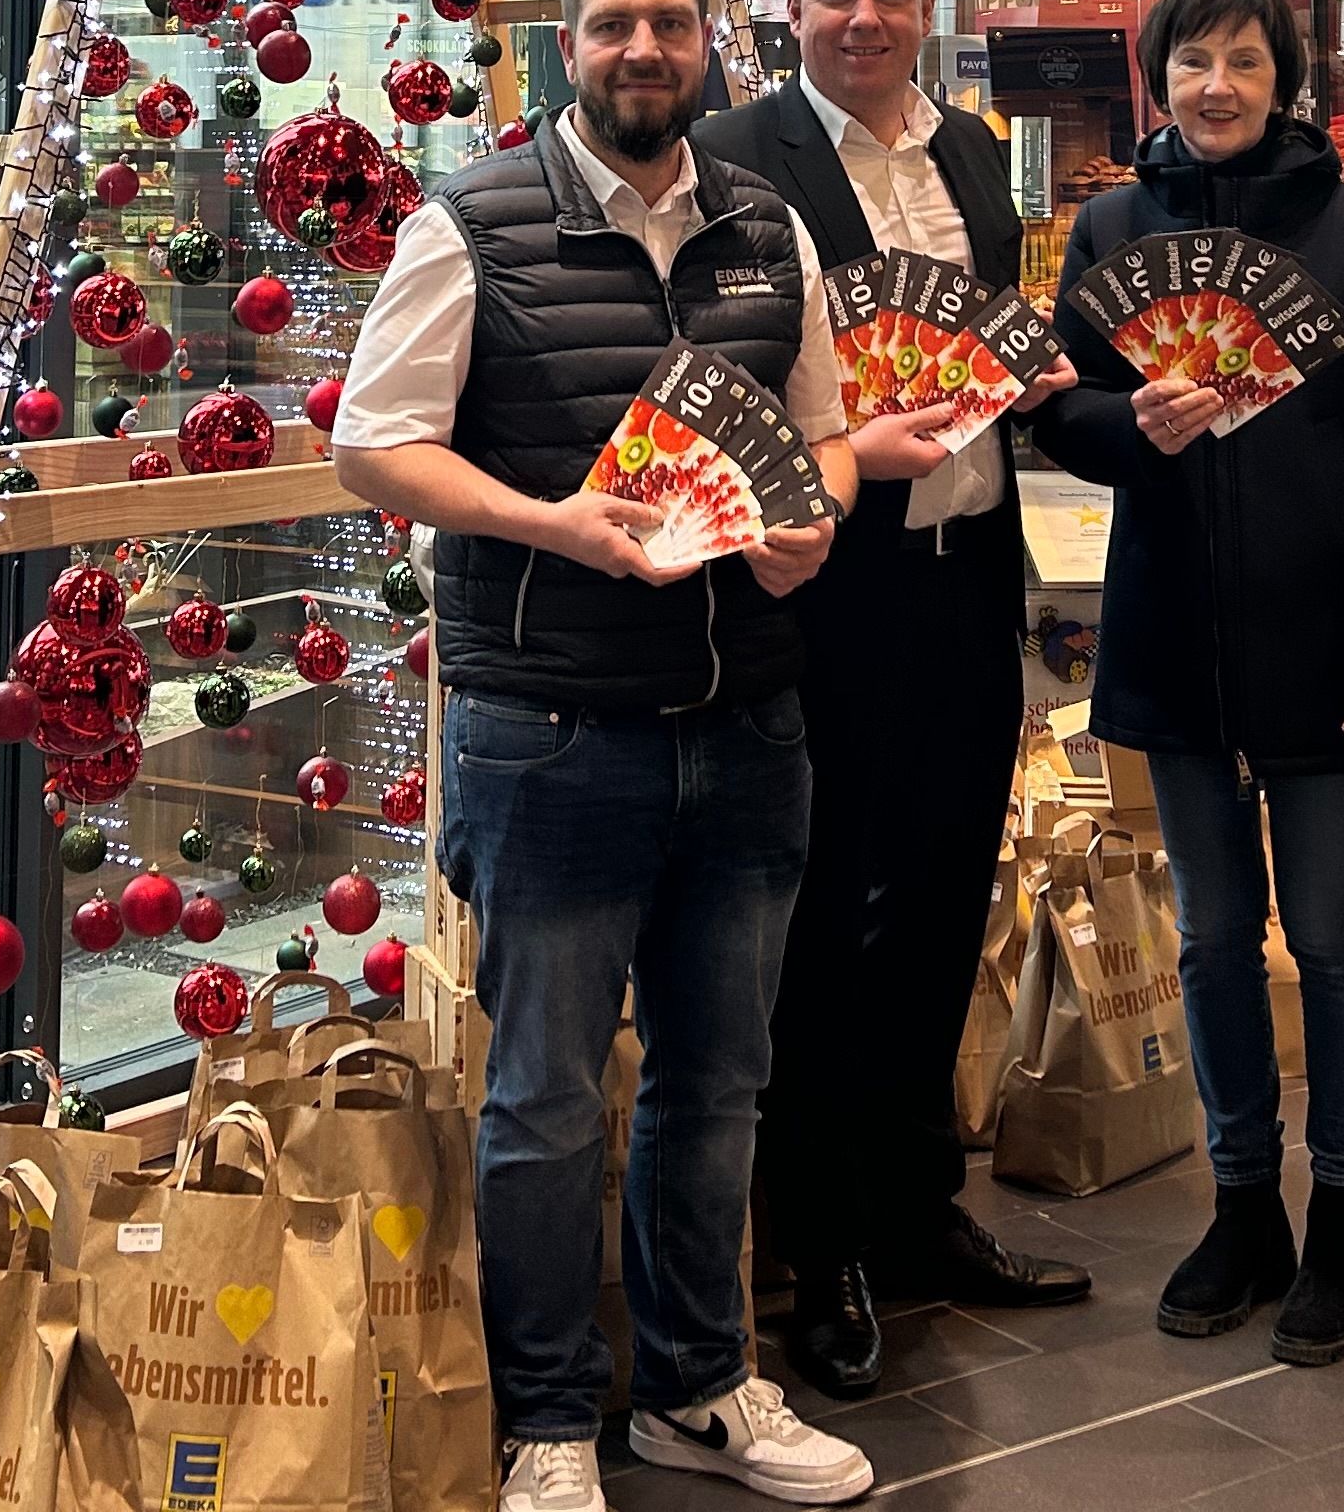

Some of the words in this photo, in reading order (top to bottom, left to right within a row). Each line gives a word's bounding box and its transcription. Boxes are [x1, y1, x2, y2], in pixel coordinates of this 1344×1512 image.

[715, 267, 769, 286] EDEKA
[1095, 942, 1137, 979] Wir
[149, 1280, 205, 1339] Wir
[105, 1343, 330, 1409] ebensmittel.
[167, 1498, 217, 1512] EDEKA
